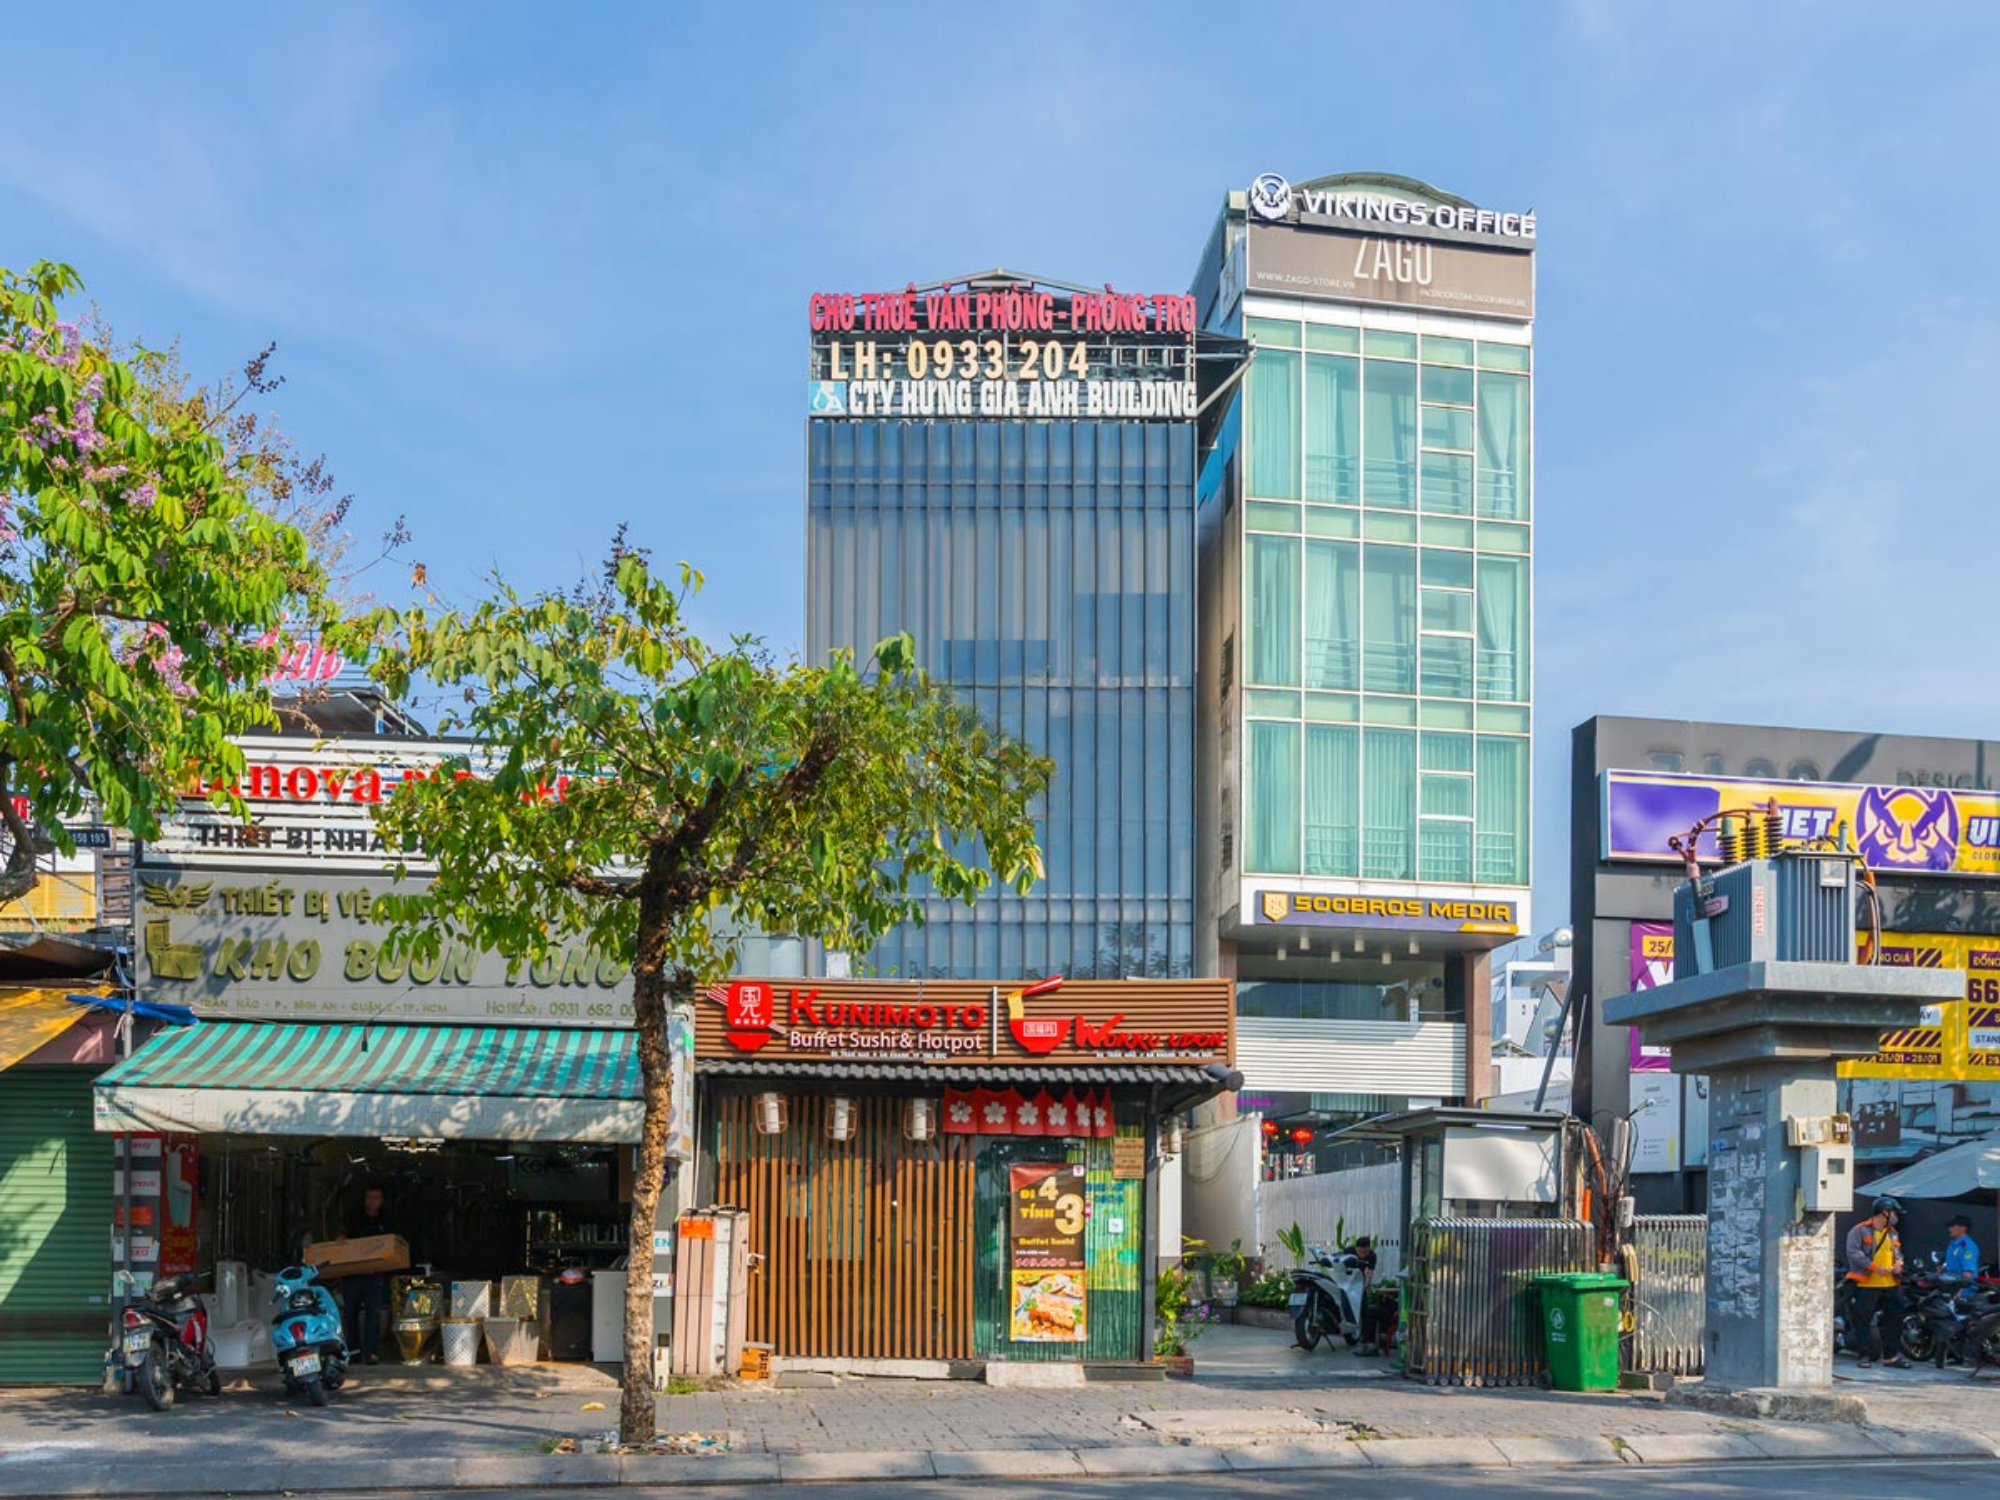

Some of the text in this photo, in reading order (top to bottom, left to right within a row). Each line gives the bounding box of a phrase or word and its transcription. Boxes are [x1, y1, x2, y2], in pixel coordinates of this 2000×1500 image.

[1302, 189, 1536, 239] VIKINGS OFFICE
[1354, 238, 1433, 285] ZAGO
[810, 292, 855, 331] CHO
[861, 283, 918, 331] THUÊ
[926, 281, 970, 331] VĂN
[976, 280, 1053, 331] PHÒNG
[1071, 283, 1147, 332] PHÒNG
[1152, 293, 1197, 343] TRỌ
[830, 339, 1089, 380] LH: 0933 204
[849, 380, 1197, 418] CTY HƯNG GIA ANH BUILDING
[222, 880, 294, 916] THIẾT
[304, 889, 329, 923] BỊ
[1294, 896, 1425, 918] SOOBROS
[1430, 901, 1511, 921] MEDIA
[213, 937, 322, 981] KHO
[550, 1002, 580, 1016] 0931
[587, 1003, 613, 1016] 652
[789, 988, 985, 1029] KUNIMOTO
[790, 1031, 982, 1052] Buffet Sushi & Hotpot
[1038, 1176, 1060, 1201] 4
[1054, 1193, 1085, 1235] 3
